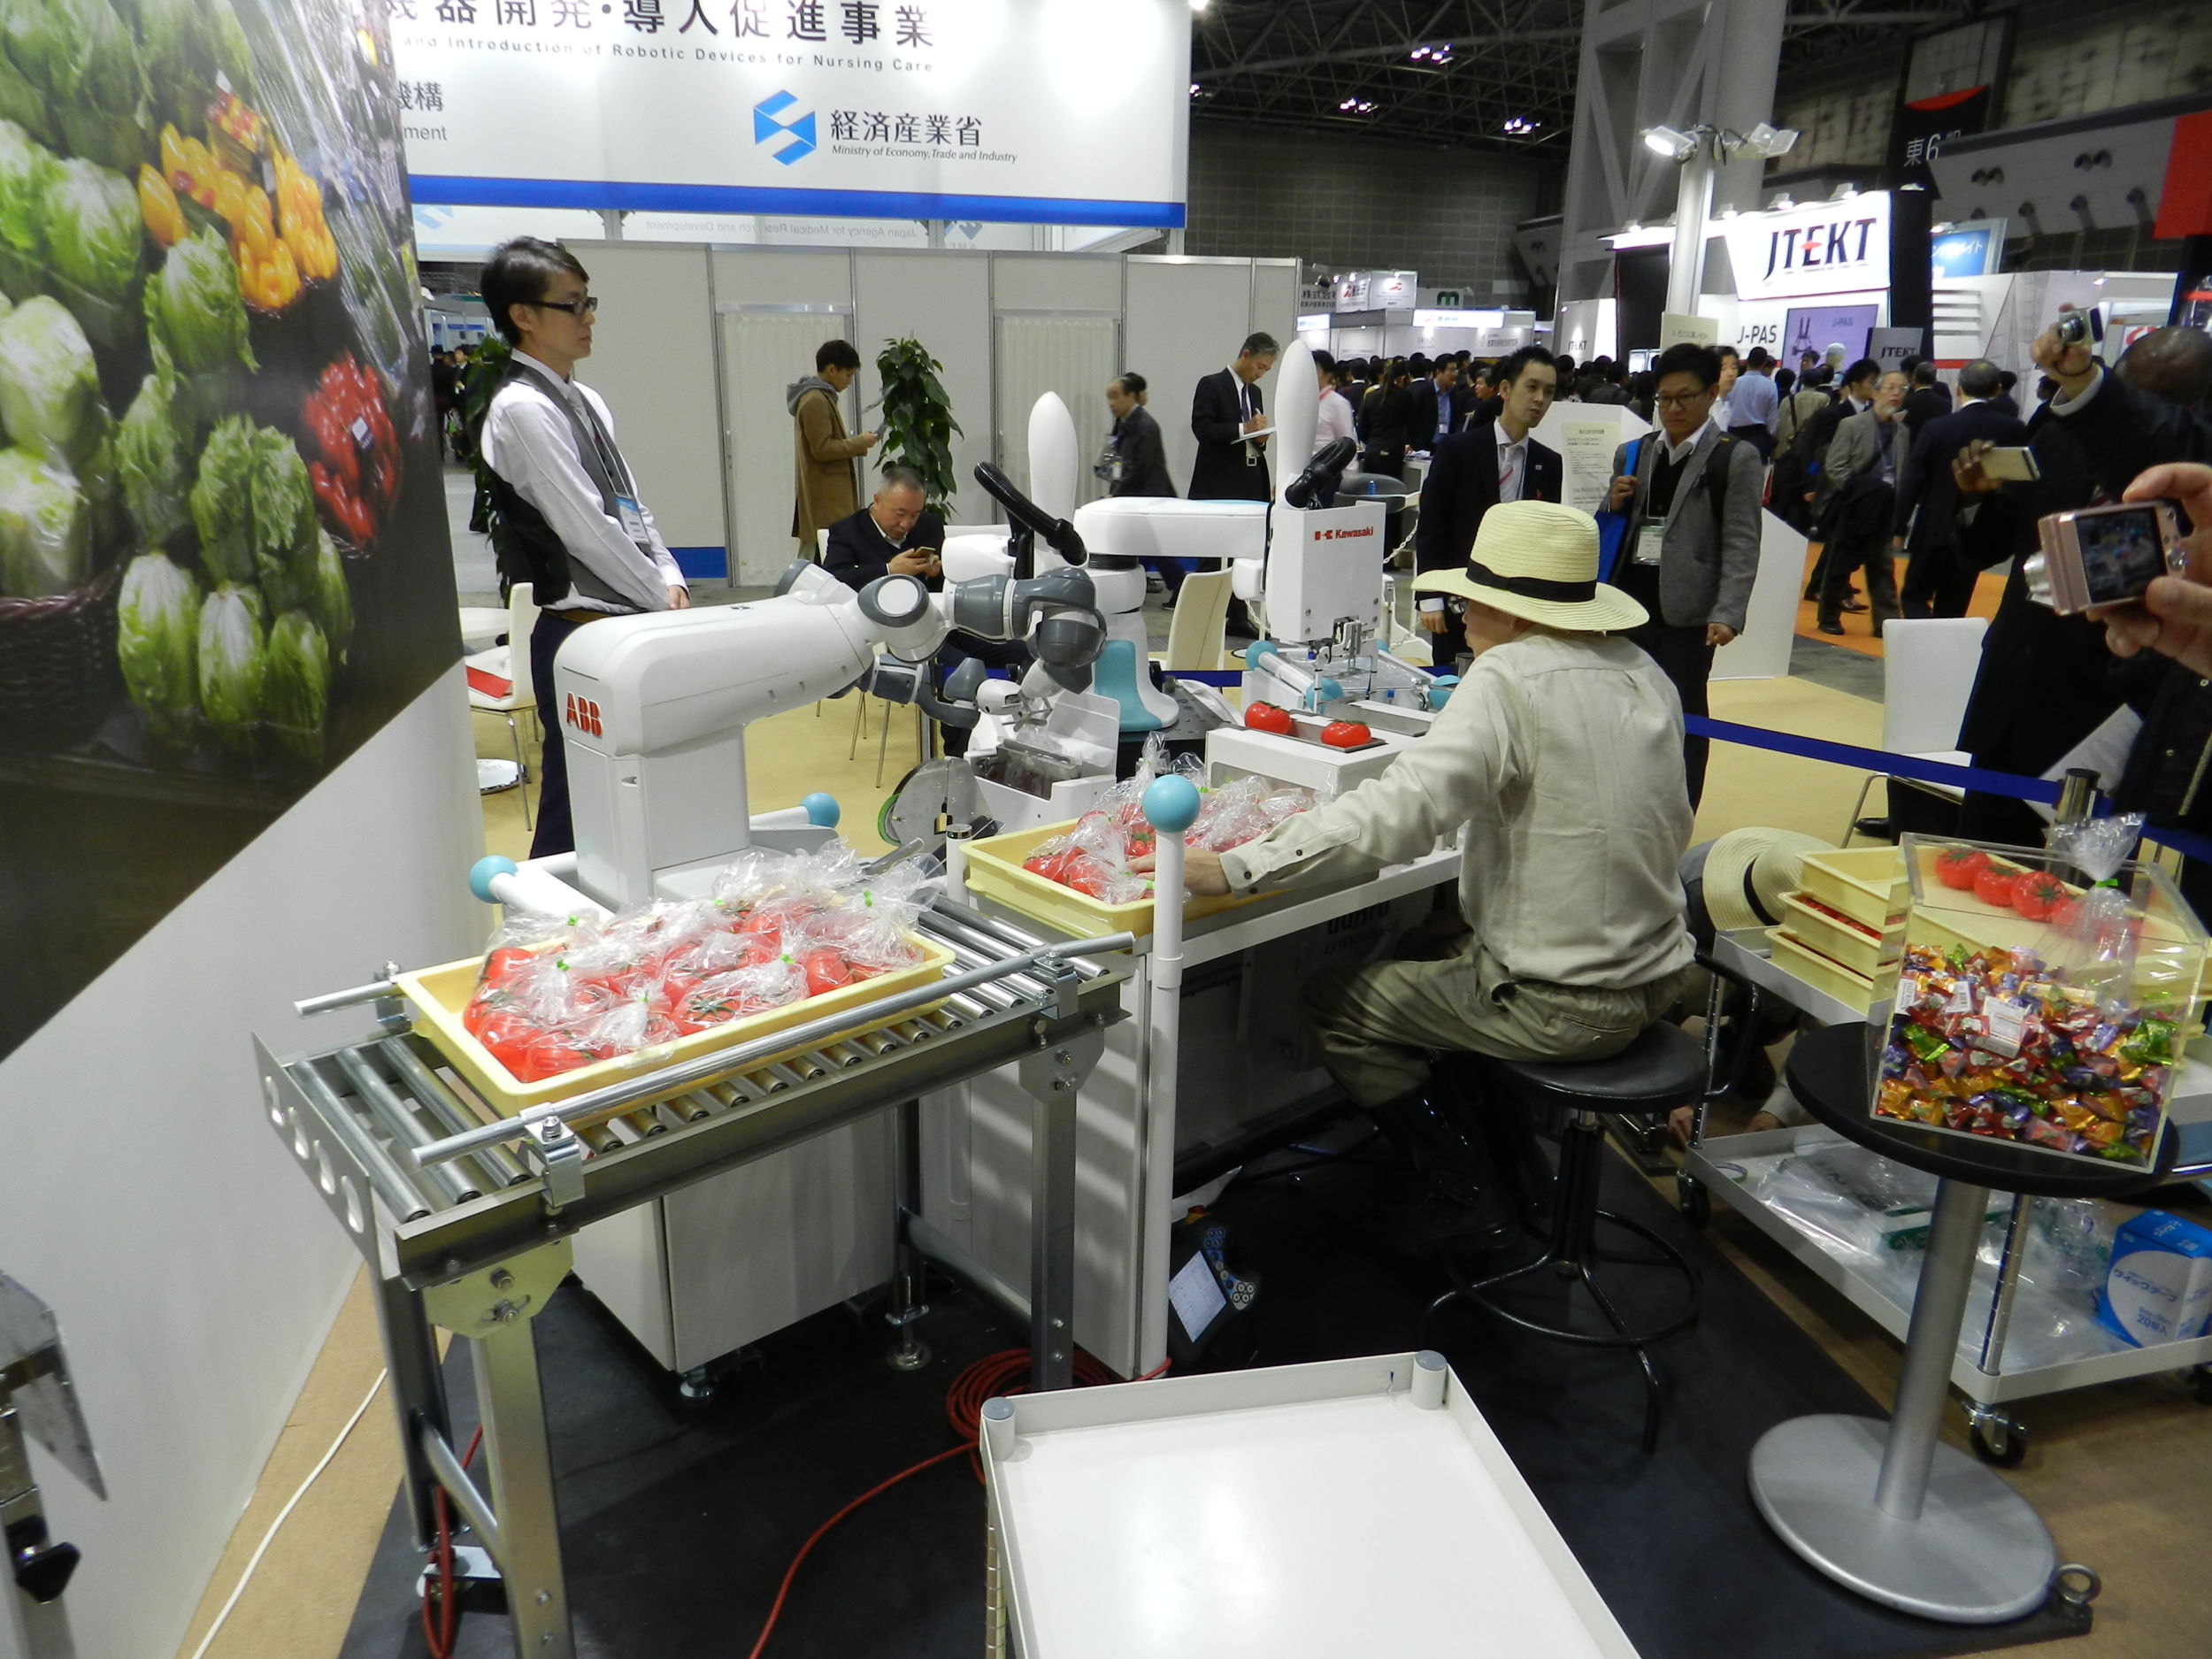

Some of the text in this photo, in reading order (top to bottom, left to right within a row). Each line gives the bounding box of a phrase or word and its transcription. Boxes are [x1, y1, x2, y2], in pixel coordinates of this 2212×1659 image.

[403, 36, 933, 72] and Introduction of Robotic Devices for Nursing Care
[830, 110, 982, 147] 経済産業省
[832, 145, 1018, 163] Ministry of Economy, Trade and Industry
[1763, 218, 1877, 281] JTEKT
[1737, 325, 1777, 344] J-PAS
[1335, 526, 1374, 539] Kawasaki
[566, 692, 603, 739] ABB
